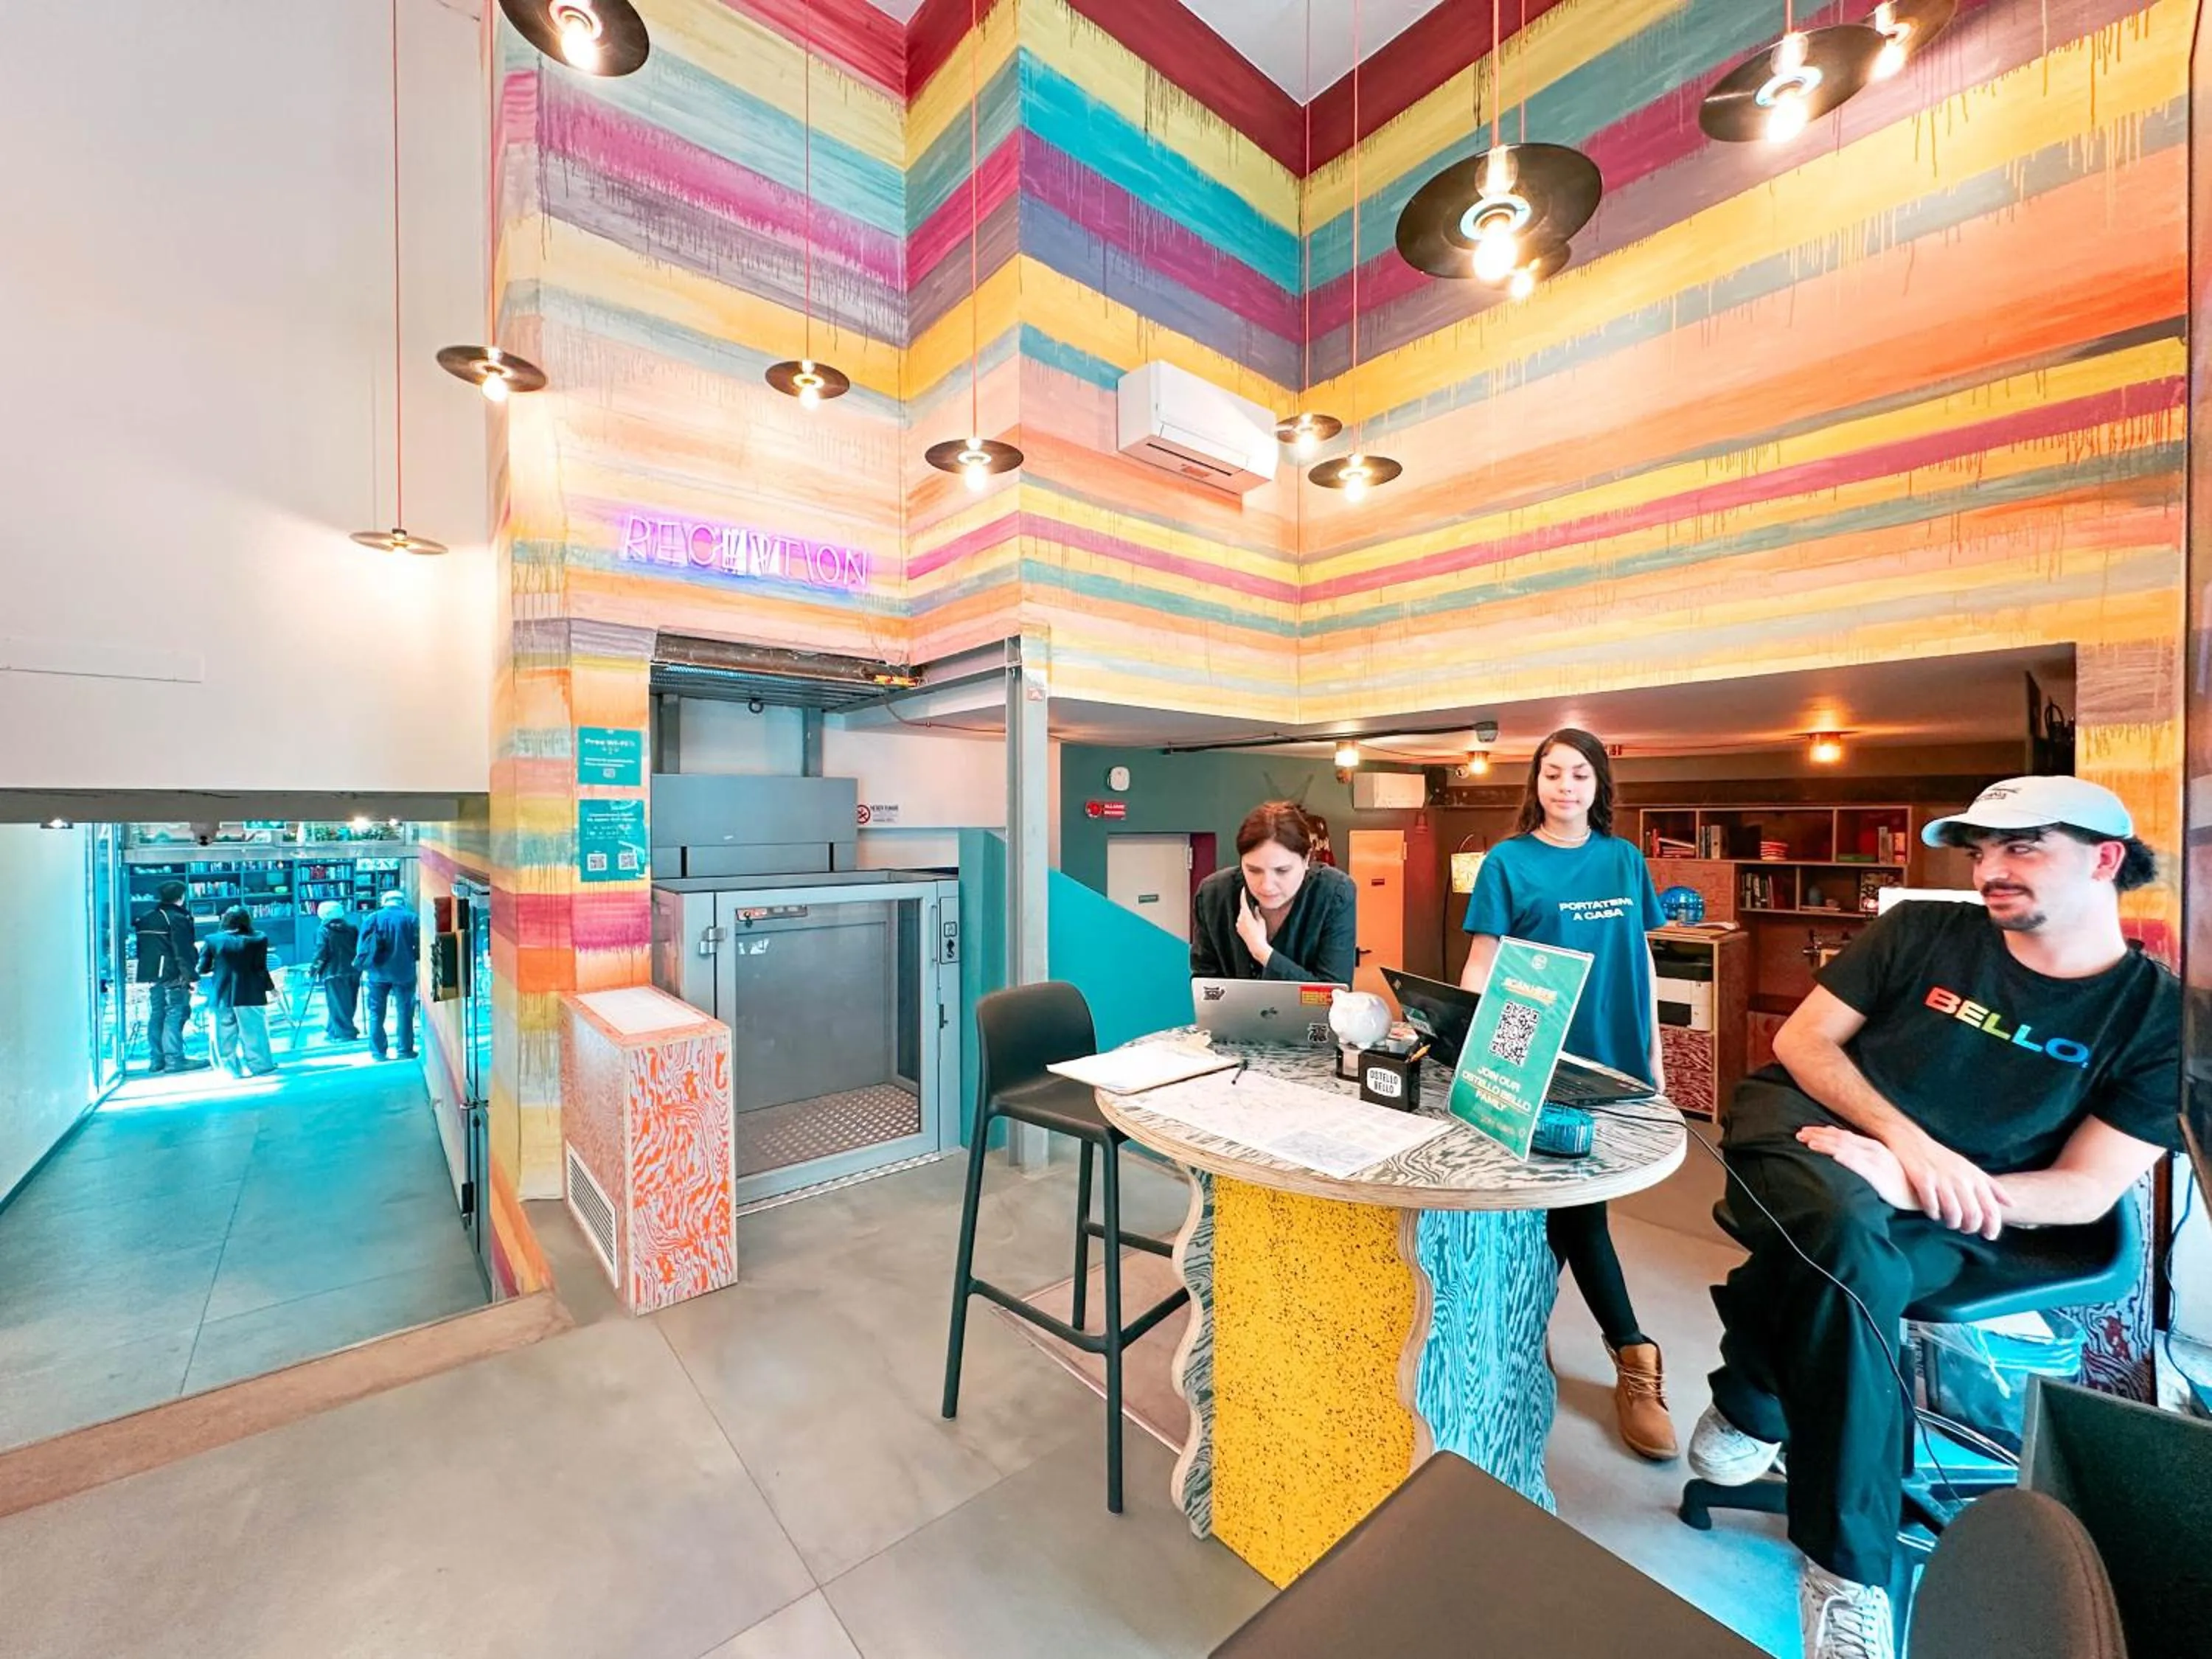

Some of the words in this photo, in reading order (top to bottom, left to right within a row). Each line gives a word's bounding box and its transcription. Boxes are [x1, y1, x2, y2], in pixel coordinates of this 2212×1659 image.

[1573, 912, 1583, 921] A
[1584, 908, 1624, 920] CASA
[1923, 986, 2090, 1063] BELLO
[1369, 1069, 1399, 1085] OSTELLO
[1374, 1080, 1394, 1094] BELLO
[1477, 1066, 1499, 1082] JOIN
[1499, 1076, 1520, 1093] OUR
[1462, 1070, 1500, 1094] OSTELLO
[1500, 1089, 1531, 1113] BELLO
[1475, 1088, 1506, 1111] FAMILY
